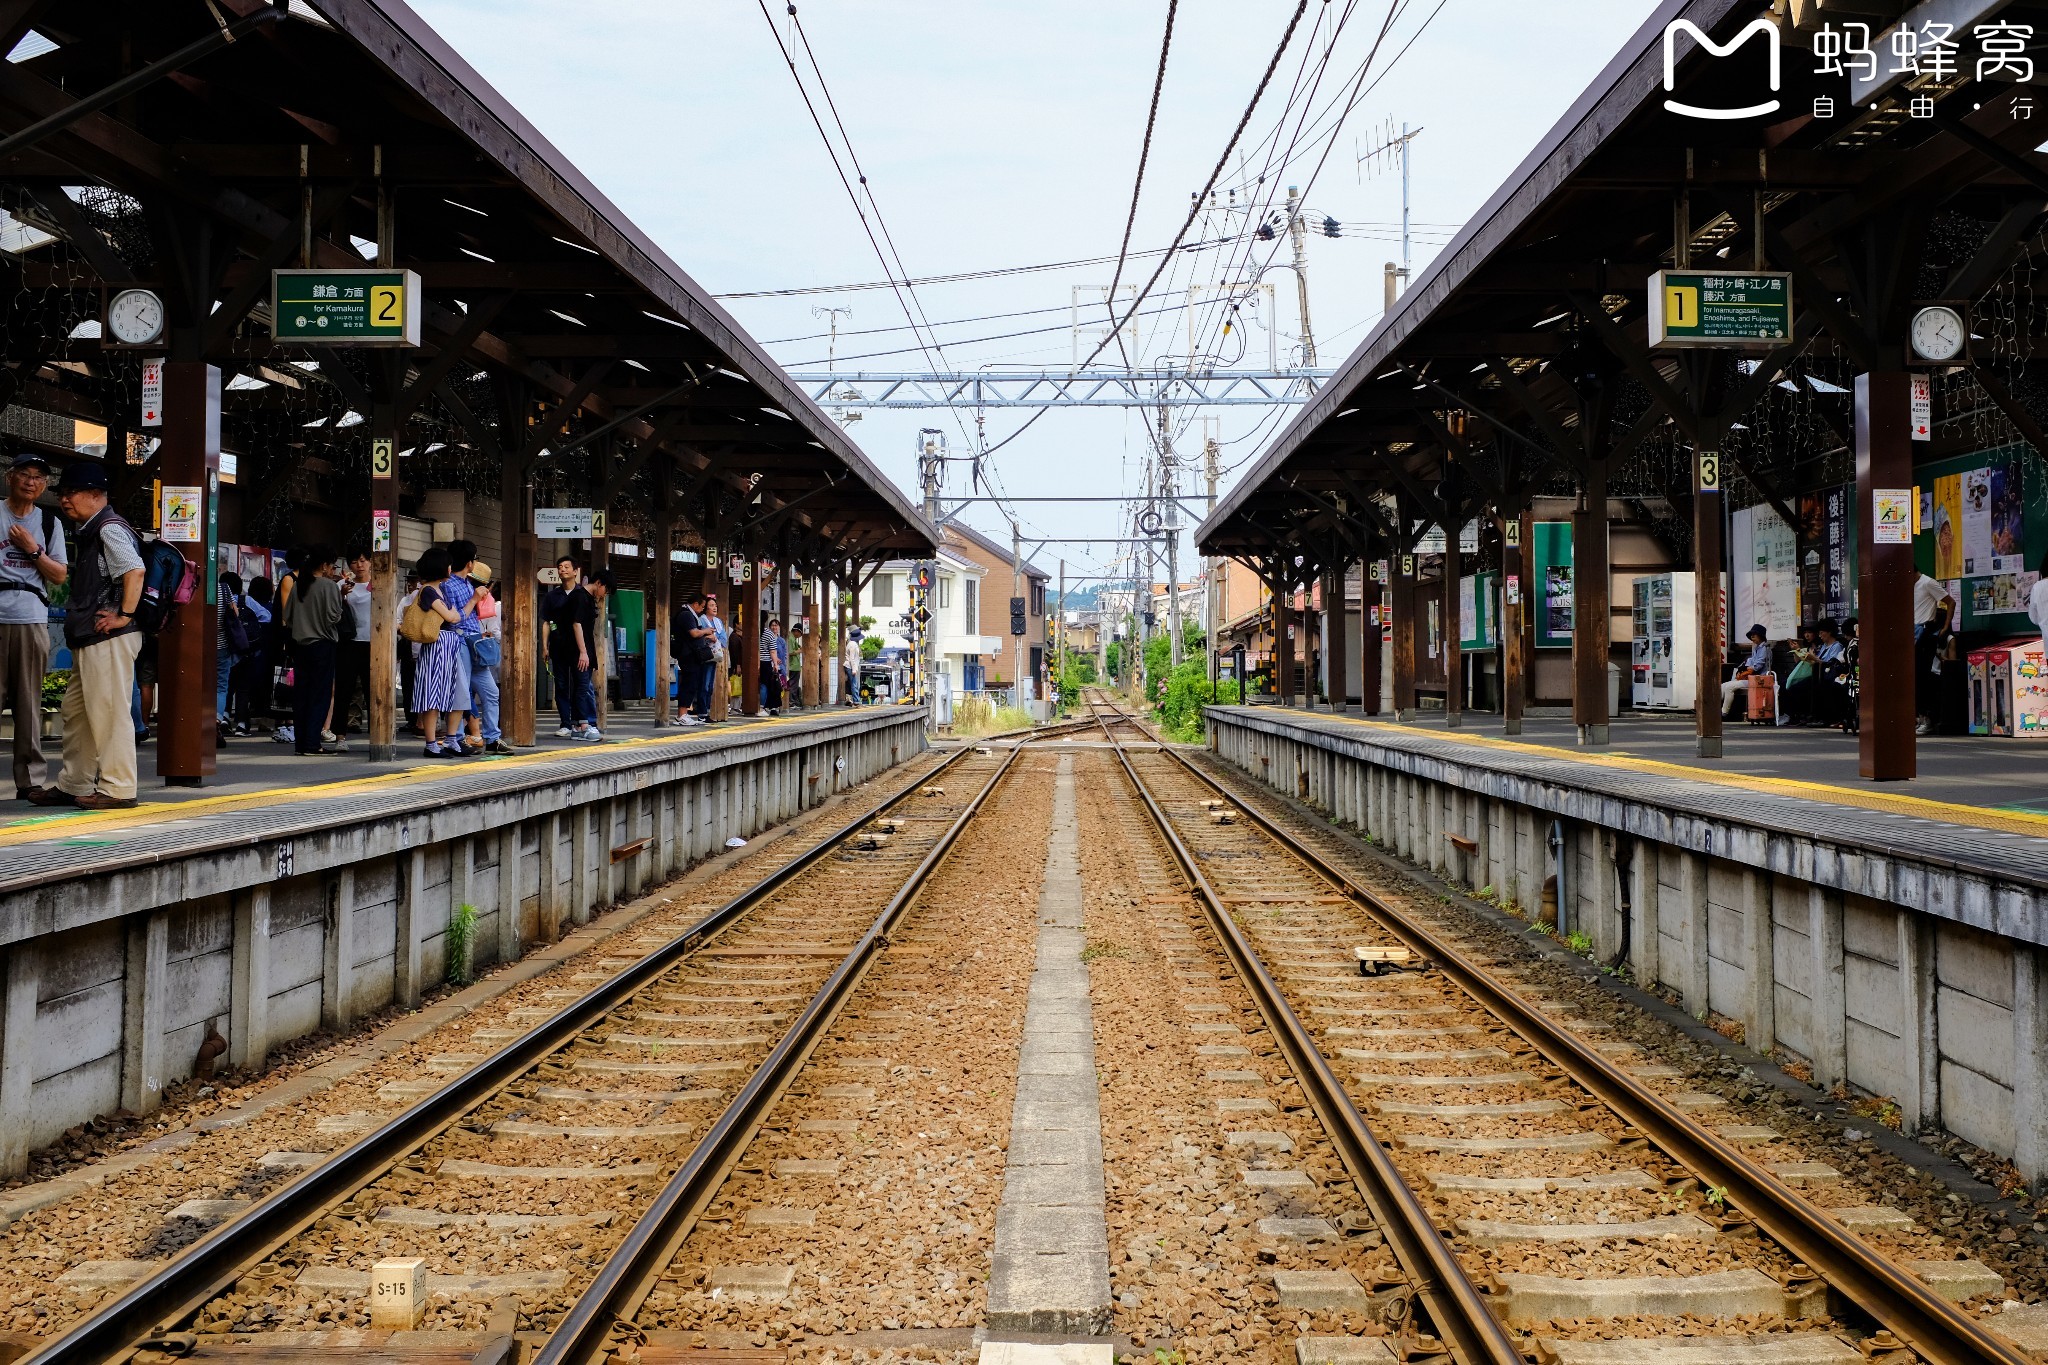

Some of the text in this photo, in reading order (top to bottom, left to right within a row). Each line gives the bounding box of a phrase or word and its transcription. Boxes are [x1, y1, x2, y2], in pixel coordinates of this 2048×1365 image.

[312, 284, 364, 298] 鎌倉 方面
[1704, 291, 1746, 302] 藤沢 方面
[314, 304, 364, 312] for Kamakura
[378, 291, 396, 320] 2
[1674, 292, 1682, 320] 1
[1714, 307, 1762, 315] Inamuragasaki,
[1752, 316, 1780, 324] Fujisawa
[374, 446, 390, 473] 3
[1702, 458, 1716, 486] 3
[593, 514, 604, 534] 4
[209, 509, 216, 560] はせ
[1507, 524, 1518, 544] 4
[1828, 494, 1841, 598] 後藤眼科
[708, 550, 716, 566] 5
[743, 566, 750, 578] 6
[1370, 566, 1378, 578] 6
[1404, 558, 1411, 573] 5
[803, 583, 810, 594] 7
[840, 592, 844, 602] 8
[1288, 596, 1294, 606] 8
[1306, 594, 1312, 604] 7
[378, 1282, 406, 1296] S=15
